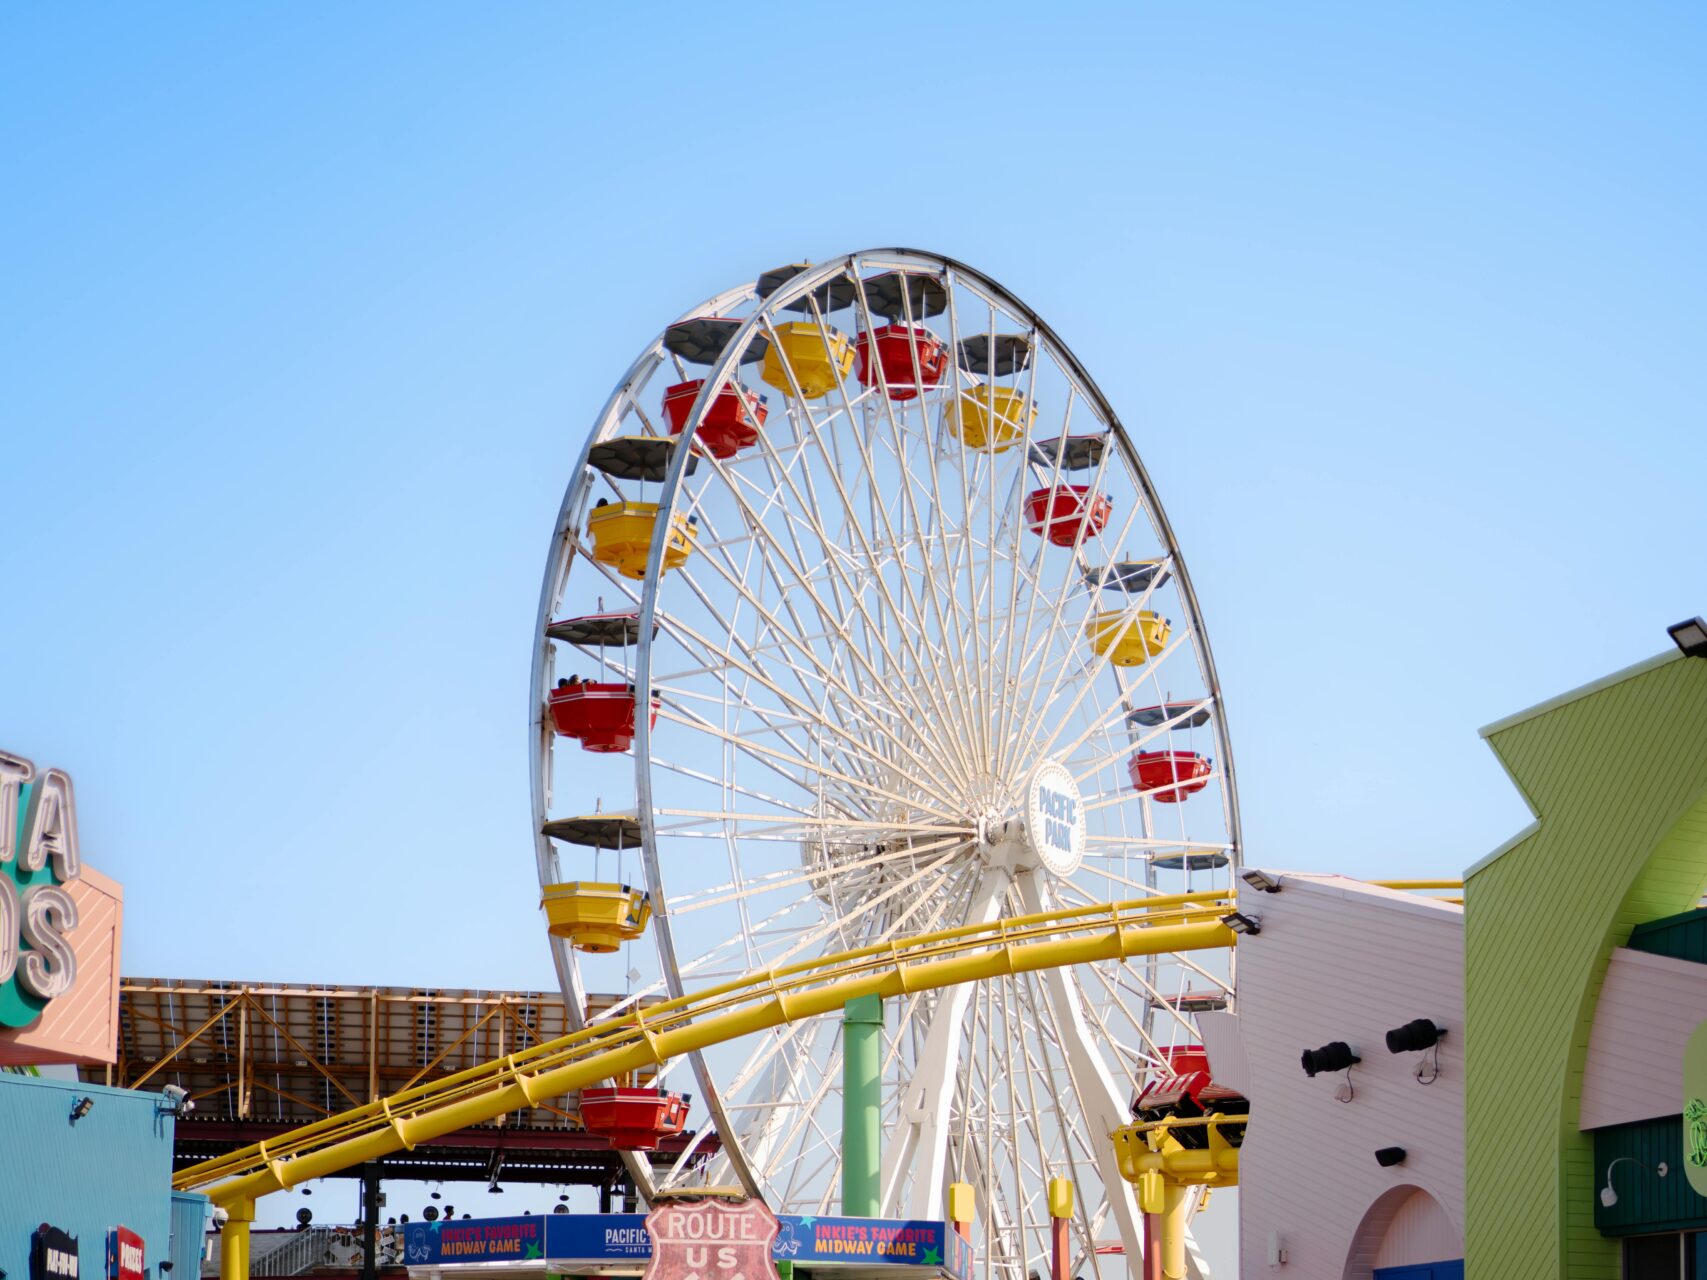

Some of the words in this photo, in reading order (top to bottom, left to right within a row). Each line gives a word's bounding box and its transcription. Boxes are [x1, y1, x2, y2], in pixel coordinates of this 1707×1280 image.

[1039, 785, 1077, 826] PACIFIC
[1045, 817, 1071, 853] PARK
[441, 1226, 482, 1242] INKIE'S
[484, 1223, 537, 1240] FAVORITE
[668, 1212, 756, 1240] ROUTE
[816, 1224, 867, 1241] INKIE'S
[871, 1227, 935, 1244] FAVORITE
[605, 1228, 647, 1244] PACIFIC
[441, 1241, 486, 1256] MIDWAY
[489, 1238, 521, 1254] GAME
[625, 1246, 645, 1254] SANTA
[815, 1238, 874, 1255] MIDWAY
[877, 1240, 917, 1257] GAME
[120, 1241, 143, 1275] PRIZES
